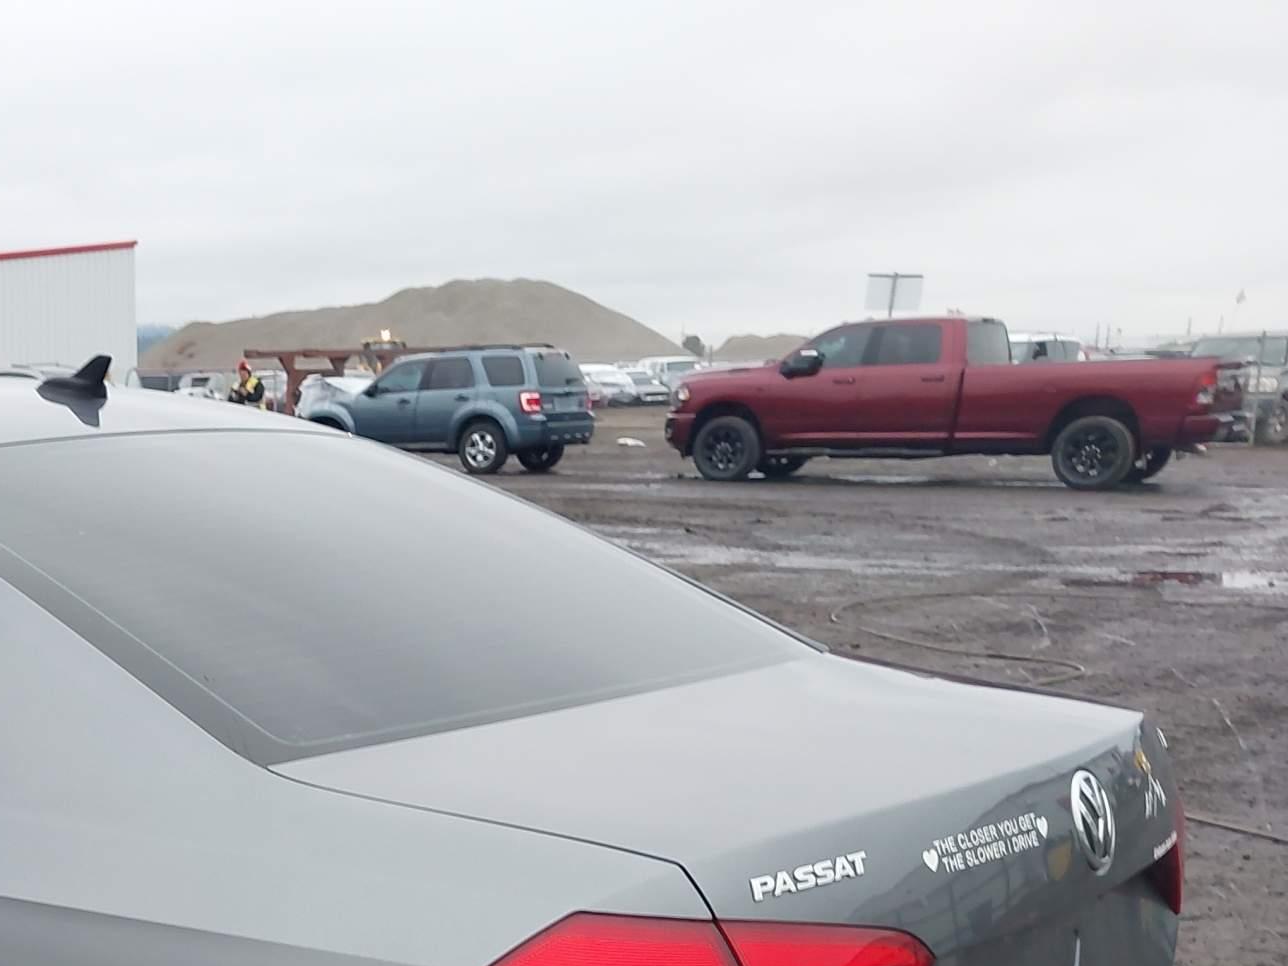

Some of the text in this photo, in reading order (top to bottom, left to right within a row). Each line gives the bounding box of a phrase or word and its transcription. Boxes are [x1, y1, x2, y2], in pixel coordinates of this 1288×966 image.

[933, 812, 1037, 857] THE CLOSER YOU GET
[942, 855, 965, 873] THE
[966, 842, 1007, 868] SLOWER
[1012, 830, 1040, 853] DRIVE
[750, 850, 866, 903] PASSAT
